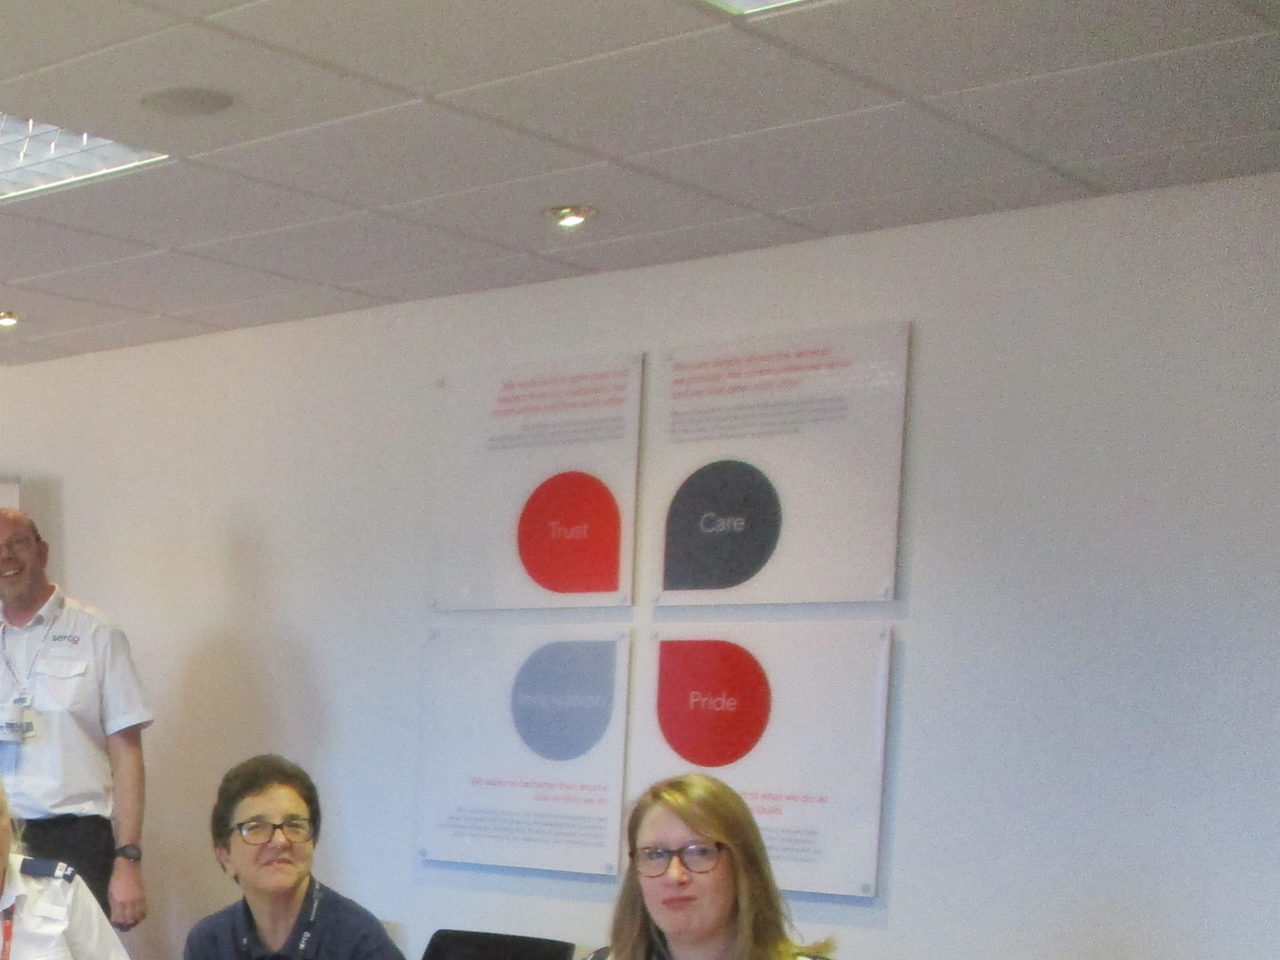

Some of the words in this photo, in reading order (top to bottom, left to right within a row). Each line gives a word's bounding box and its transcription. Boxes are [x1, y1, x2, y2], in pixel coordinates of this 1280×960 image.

[548, 521, 589, 540] Trust
[700, 512, 746, 533] Care
[688, 690, 738, 712] Pride
